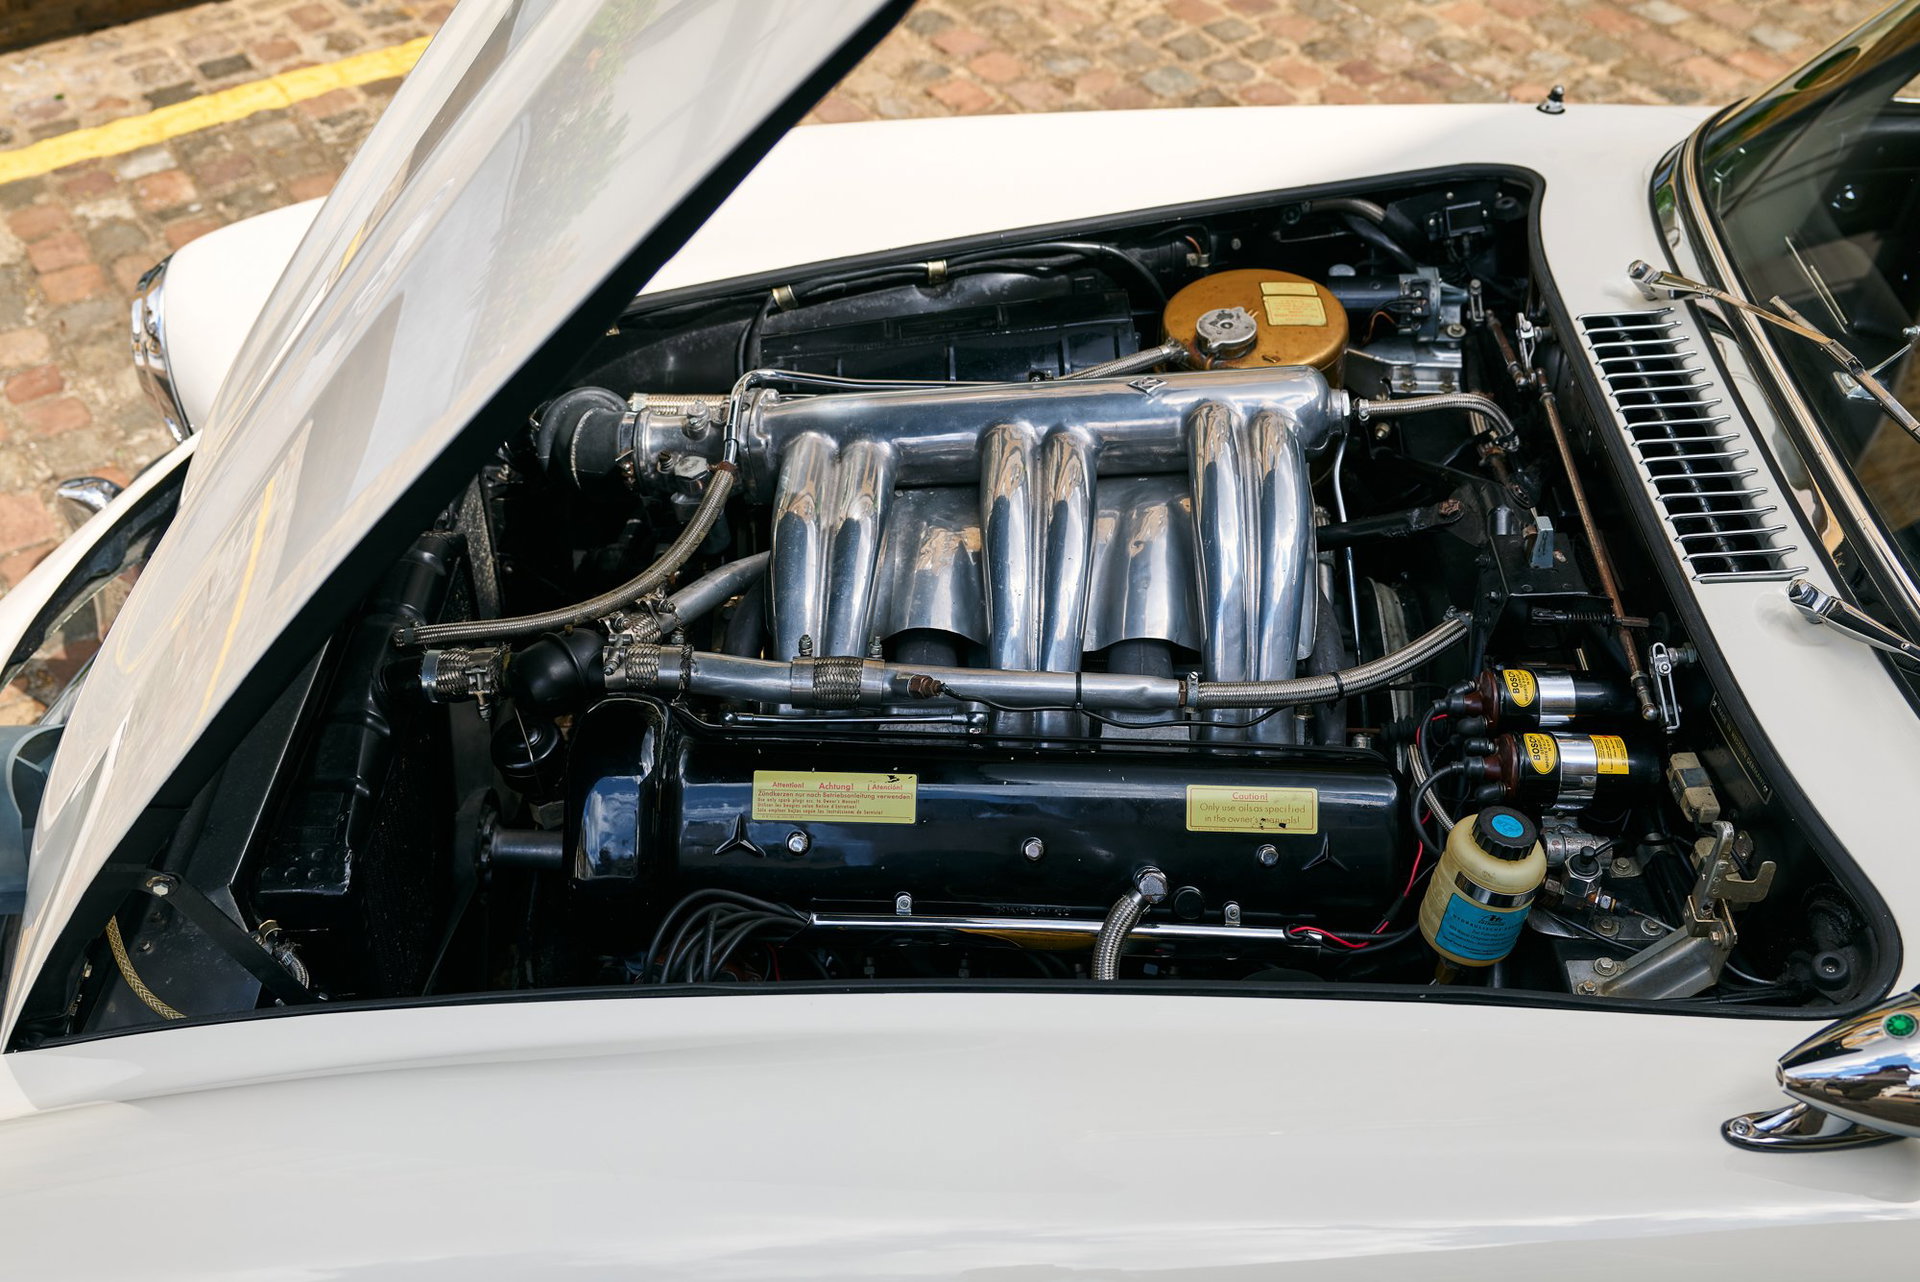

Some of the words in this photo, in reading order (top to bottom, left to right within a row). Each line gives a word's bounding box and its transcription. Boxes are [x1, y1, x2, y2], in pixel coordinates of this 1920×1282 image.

[772, 781, 805, 789] Attention!
[818, 782, 854, 791] Achtung!
[822, 792, 876, 800] Betriebsanleitung
[876, 792, 914, 800] verwenden!
[1232, 791, 1268, 800] Caution!
[1200, 802, 1220, 812] Only
[1238, 803, 1252, 812] oils
[1252, 805, 1263, 813] as
[1265, 804, 1306, 815] specified
[1213, 814, 1227, 823] the
[1227, 816, 1259, 824] owner's
